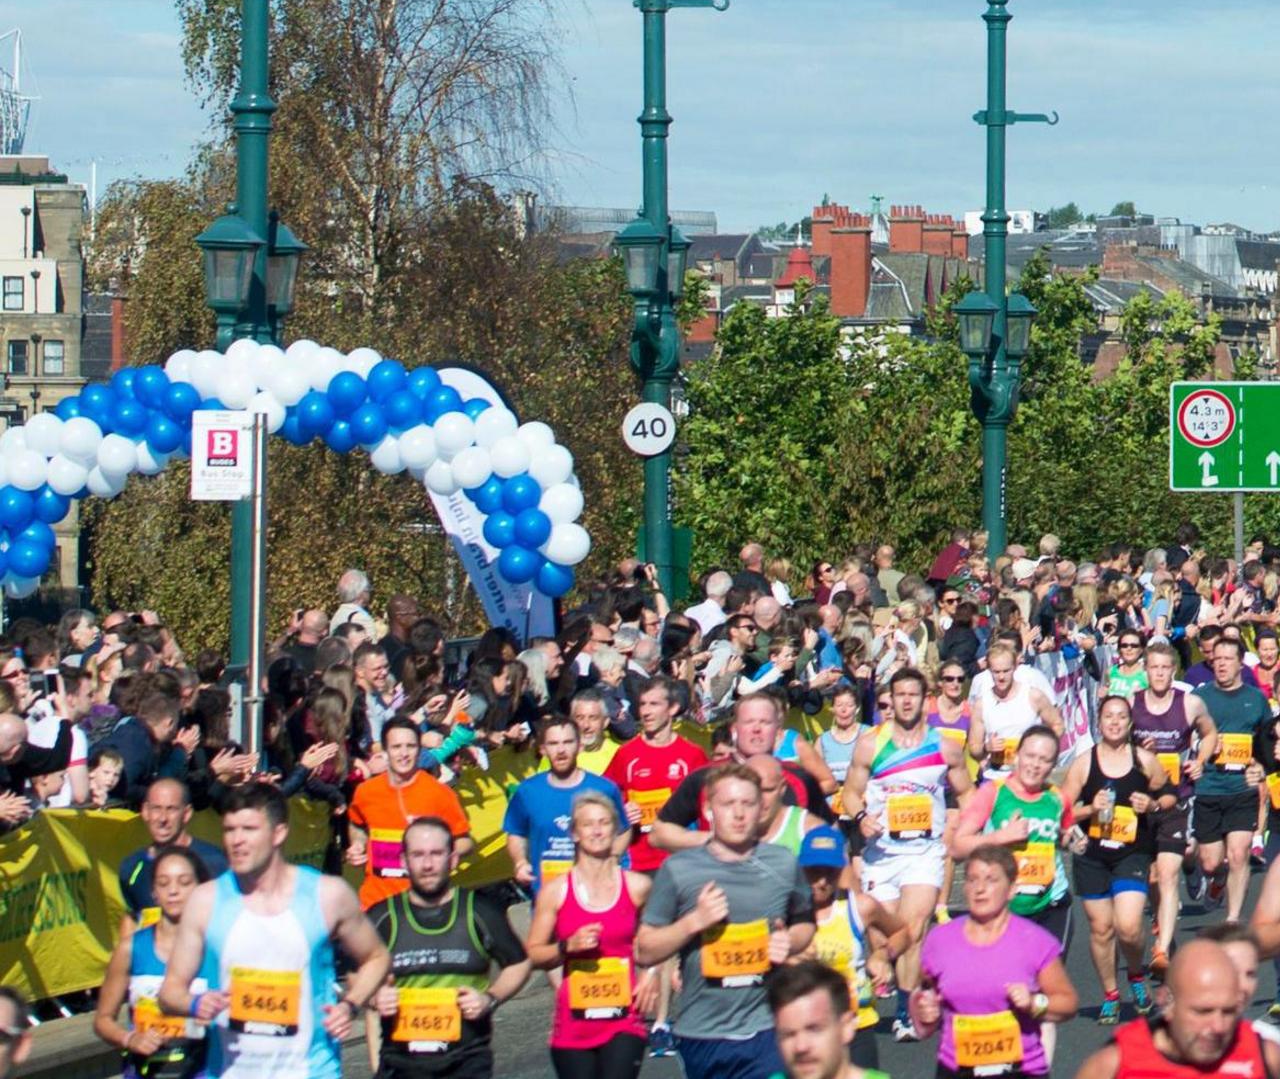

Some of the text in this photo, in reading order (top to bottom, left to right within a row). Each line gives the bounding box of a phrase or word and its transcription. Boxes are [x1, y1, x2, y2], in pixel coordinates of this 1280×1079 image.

[1190, 405, 1225, 416] 4.3 m
[632, 417, 667, 438] 40
[212, 432, 233, 455] B
[580, 983, 621, 999] 9850
[242, 993, 289, 1012] 8464
[400, 1013, 454, 1031] 14687
[963, 1037, 1015, 1056] 12047
